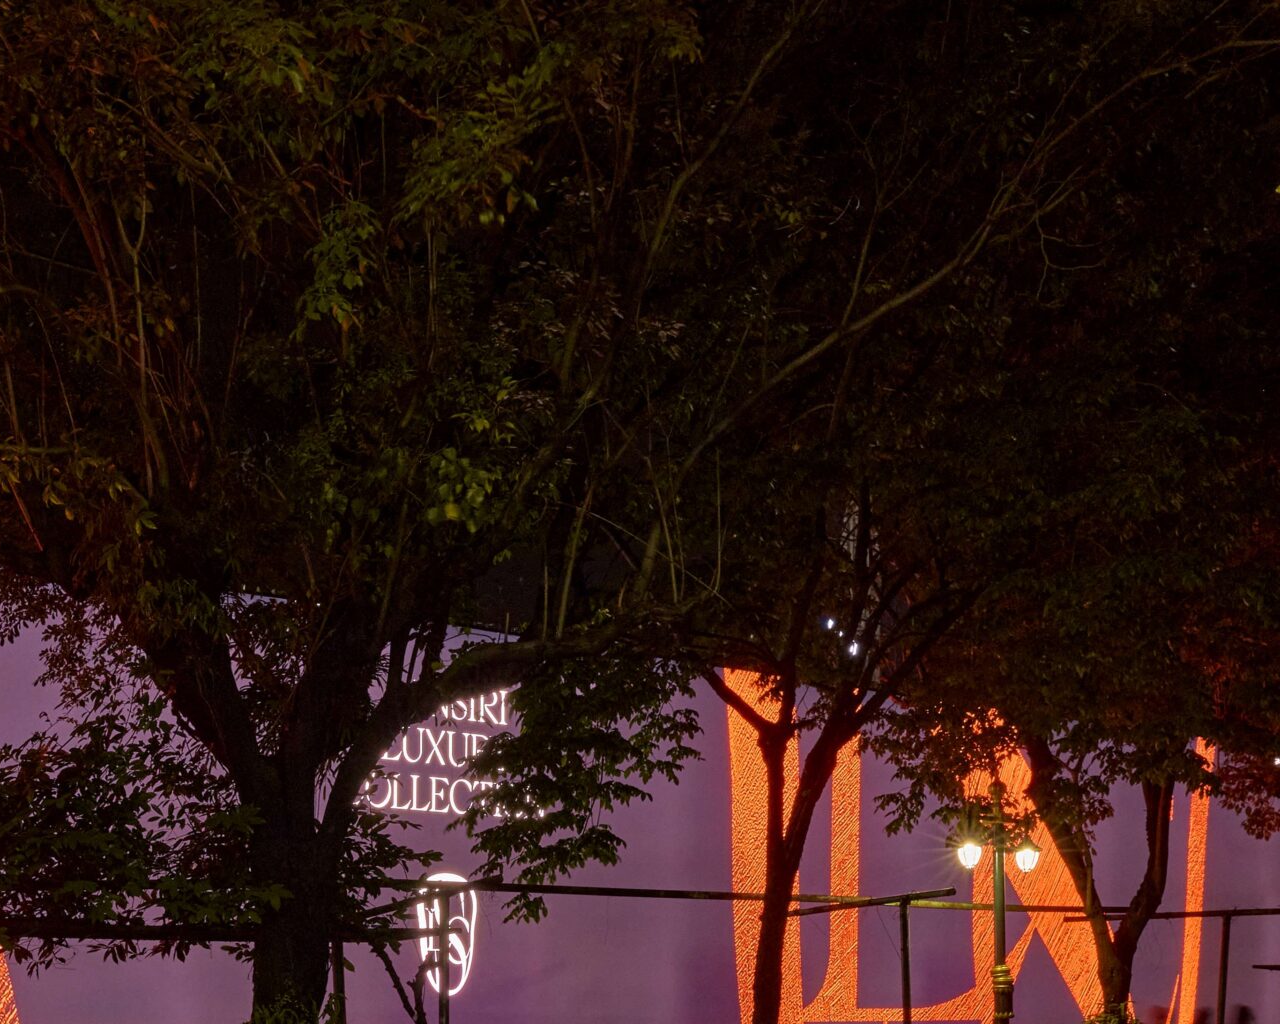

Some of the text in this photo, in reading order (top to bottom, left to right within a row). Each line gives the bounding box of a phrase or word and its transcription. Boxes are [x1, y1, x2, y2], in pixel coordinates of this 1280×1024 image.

[432, 690, 508, 726] SIRI
[381, 727, 492, 767] LUXU
[354, 771, 545, 818] OLLECT
